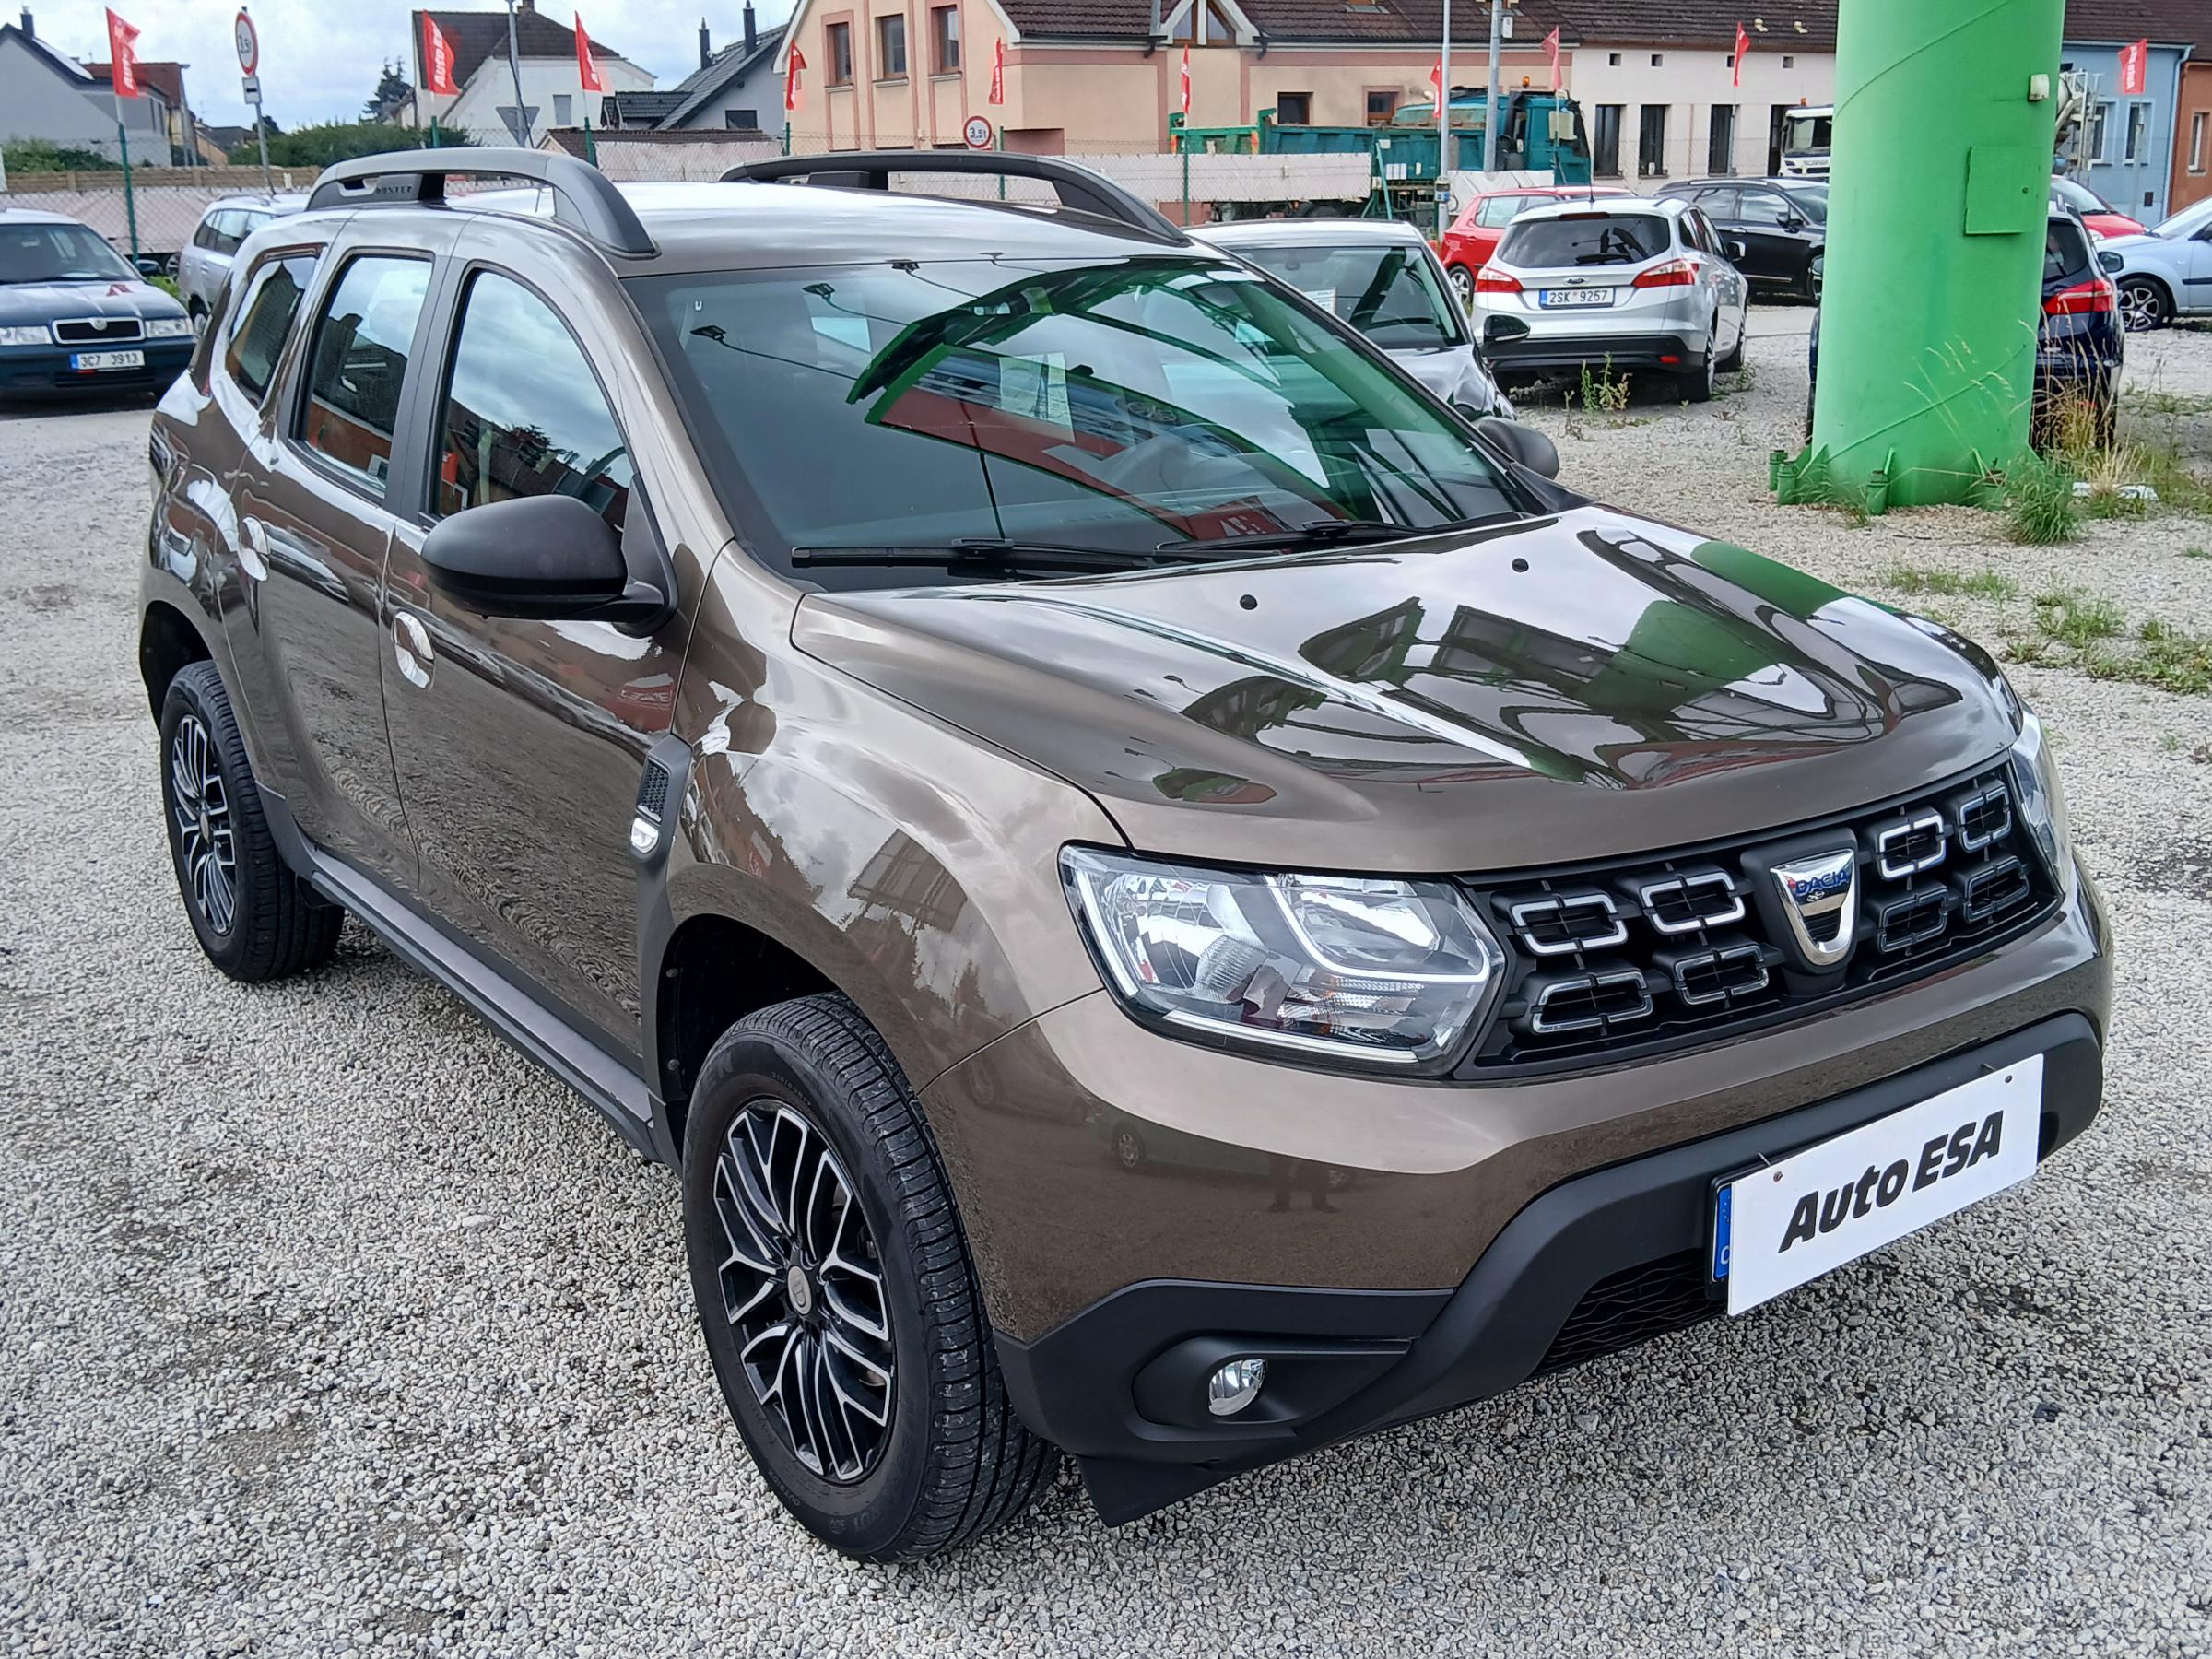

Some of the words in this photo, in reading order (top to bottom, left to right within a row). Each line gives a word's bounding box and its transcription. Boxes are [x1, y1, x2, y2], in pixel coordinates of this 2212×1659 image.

[1549, 291, 1571, 303] 2SK
[1579, 289, 1608, 302] 9257
[1795, 869, 1849, 897] DACIA
[1778, 1159, 1909, 1254] Auto
[1912, 1110, 2004, 1193] ESA
